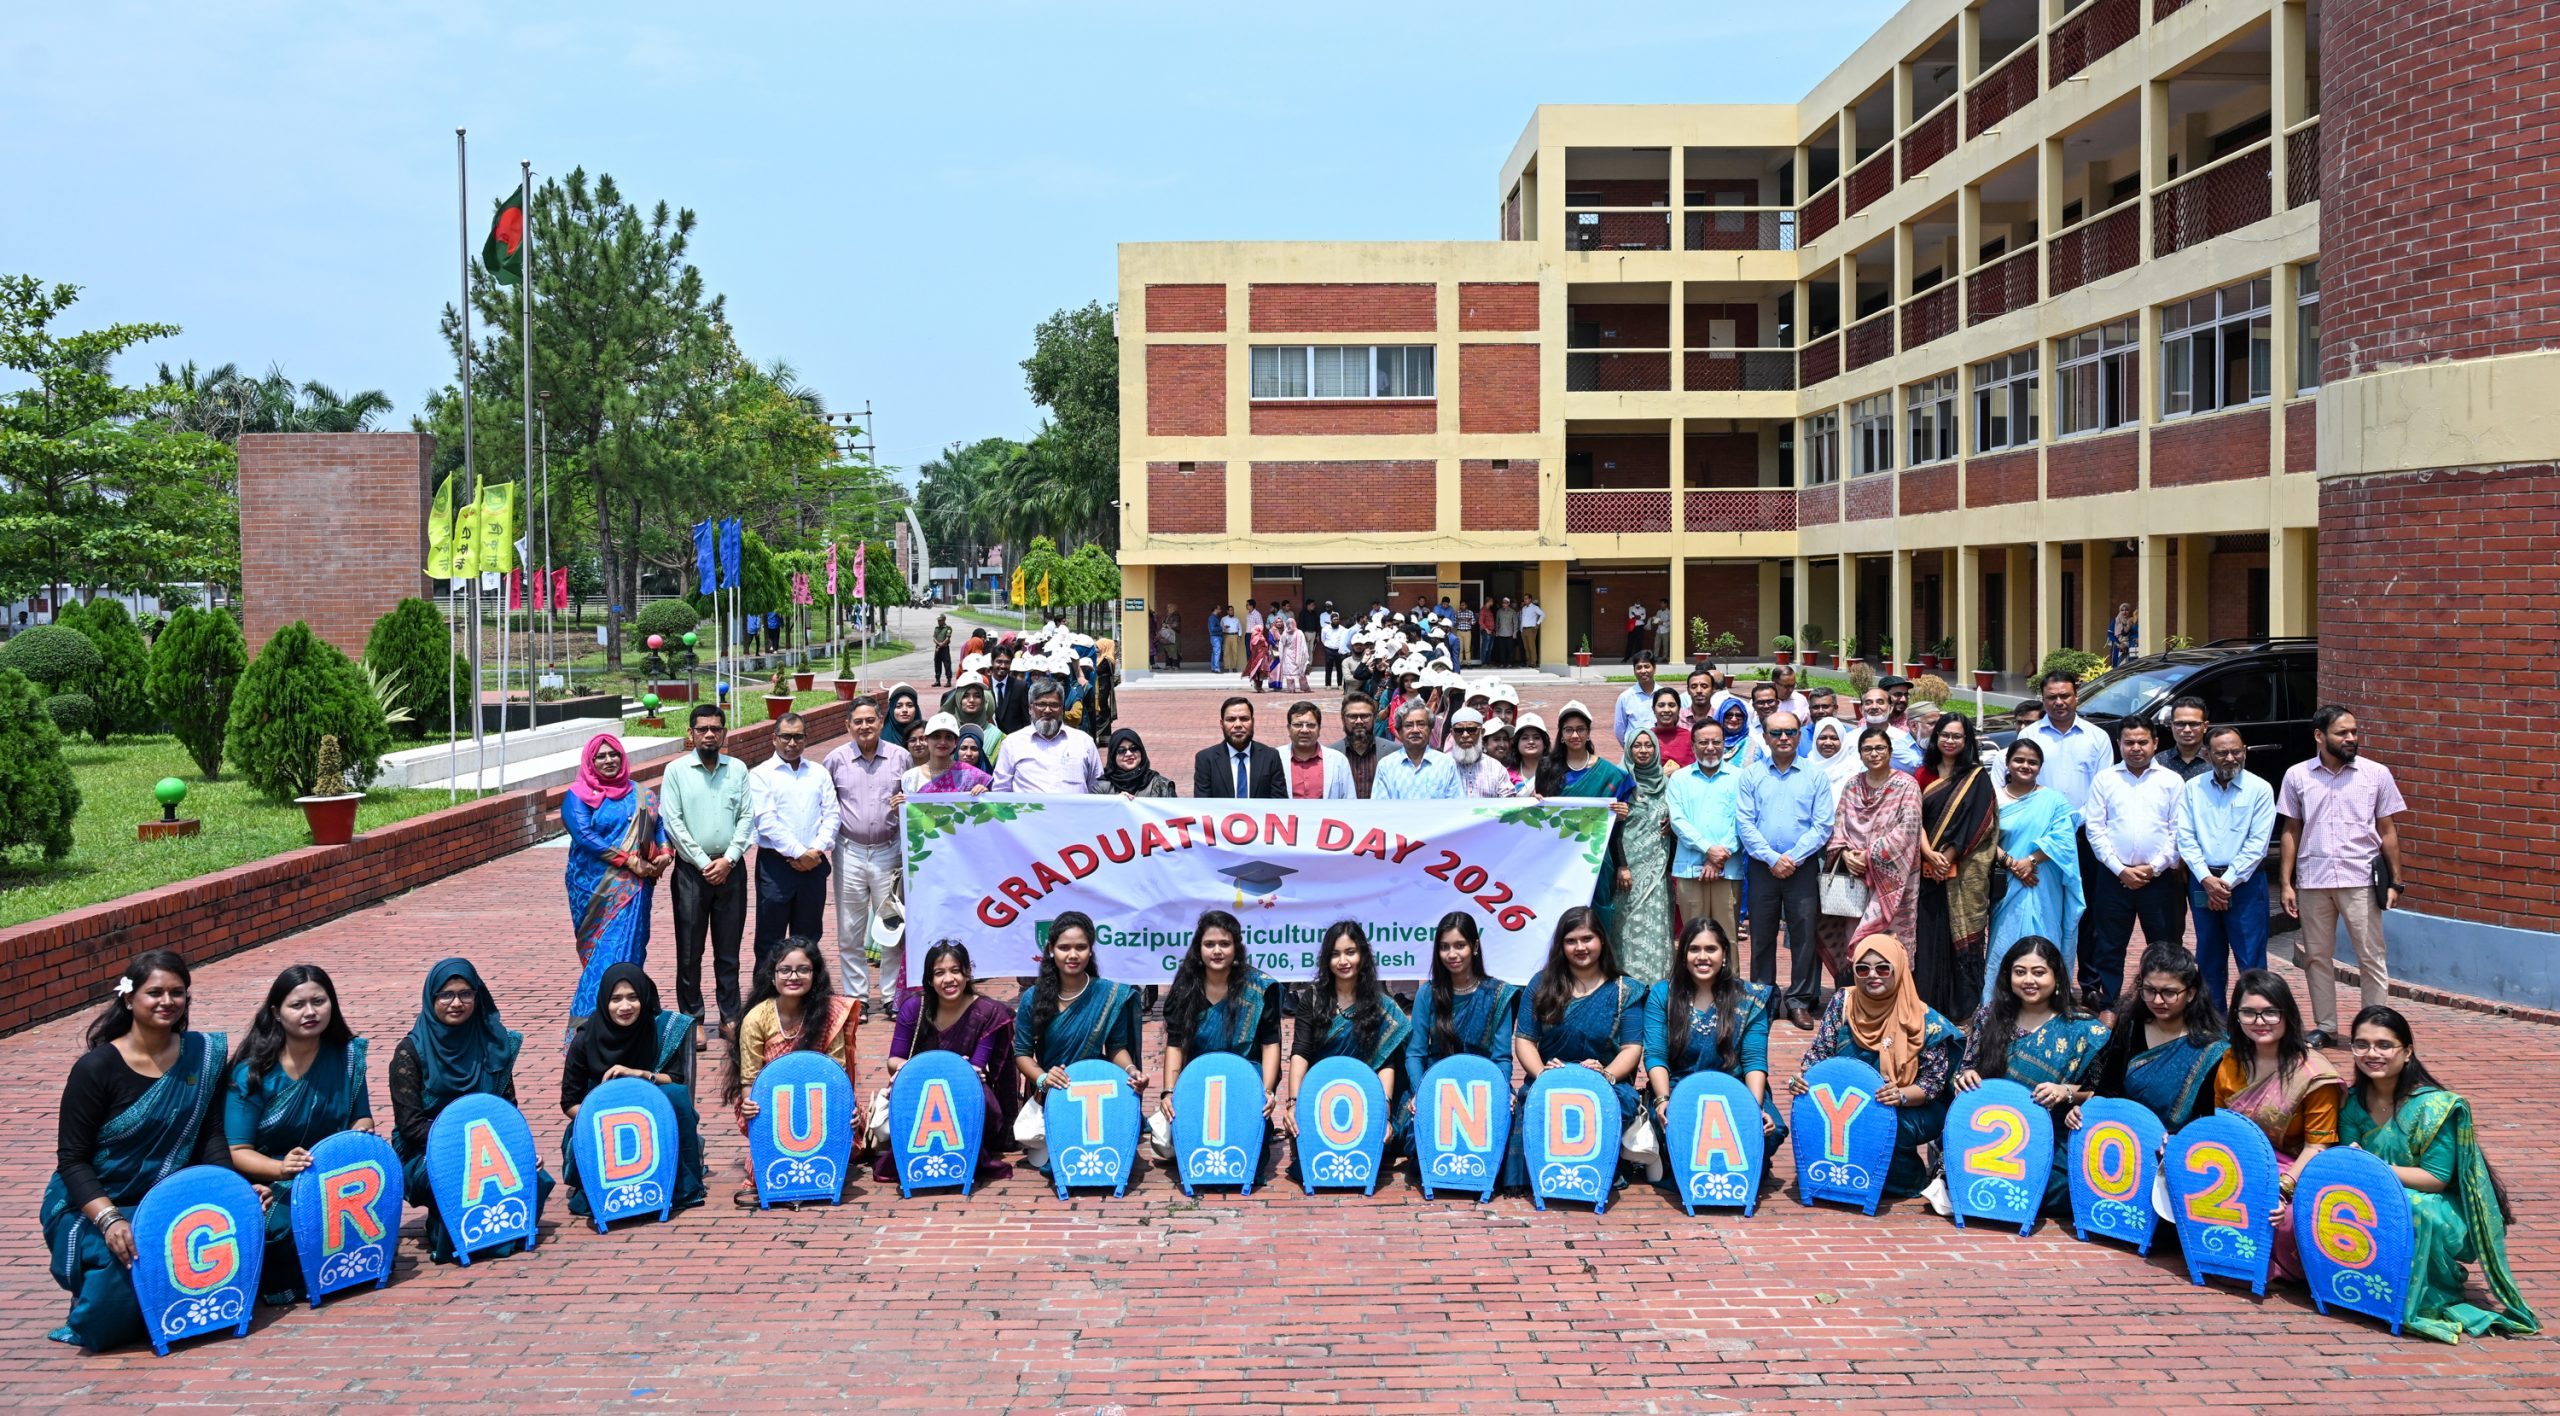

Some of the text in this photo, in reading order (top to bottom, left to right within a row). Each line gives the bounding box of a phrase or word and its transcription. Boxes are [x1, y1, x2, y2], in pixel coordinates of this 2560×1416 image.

[976, 813, 1537, 932] GRADUATION DAY 2026
[1094, 924, 1193, 952] Gazipur
[593, 1106, 659, 1188] D
[772, 1081, 827, 1157] U
[908, 1079, 964, 1154] A
[1068, 1080, 1118, 1145] T
[1203, 1075, 1226, 1146] I
[1314, 1078, 1368, 1151] O
[1435, 1078, 1492, 1152] N
[1544, 1088, 1602, 1163] D
[1690, 1094, 1749, 1171] A
[1809, 1084, 1870, 1162] Y
[1964, 1104, 2030, 1180] 2
[461, 1117, 523, 1208] A
[2082, 1121, 2142, 1201] 0
[2184, 1141, 2249, 1229] 2
[319, 1160, 386, 1256] R
[2311, 1184, 2379, 1269] 6
[165, 1203, 240, 1295] G
